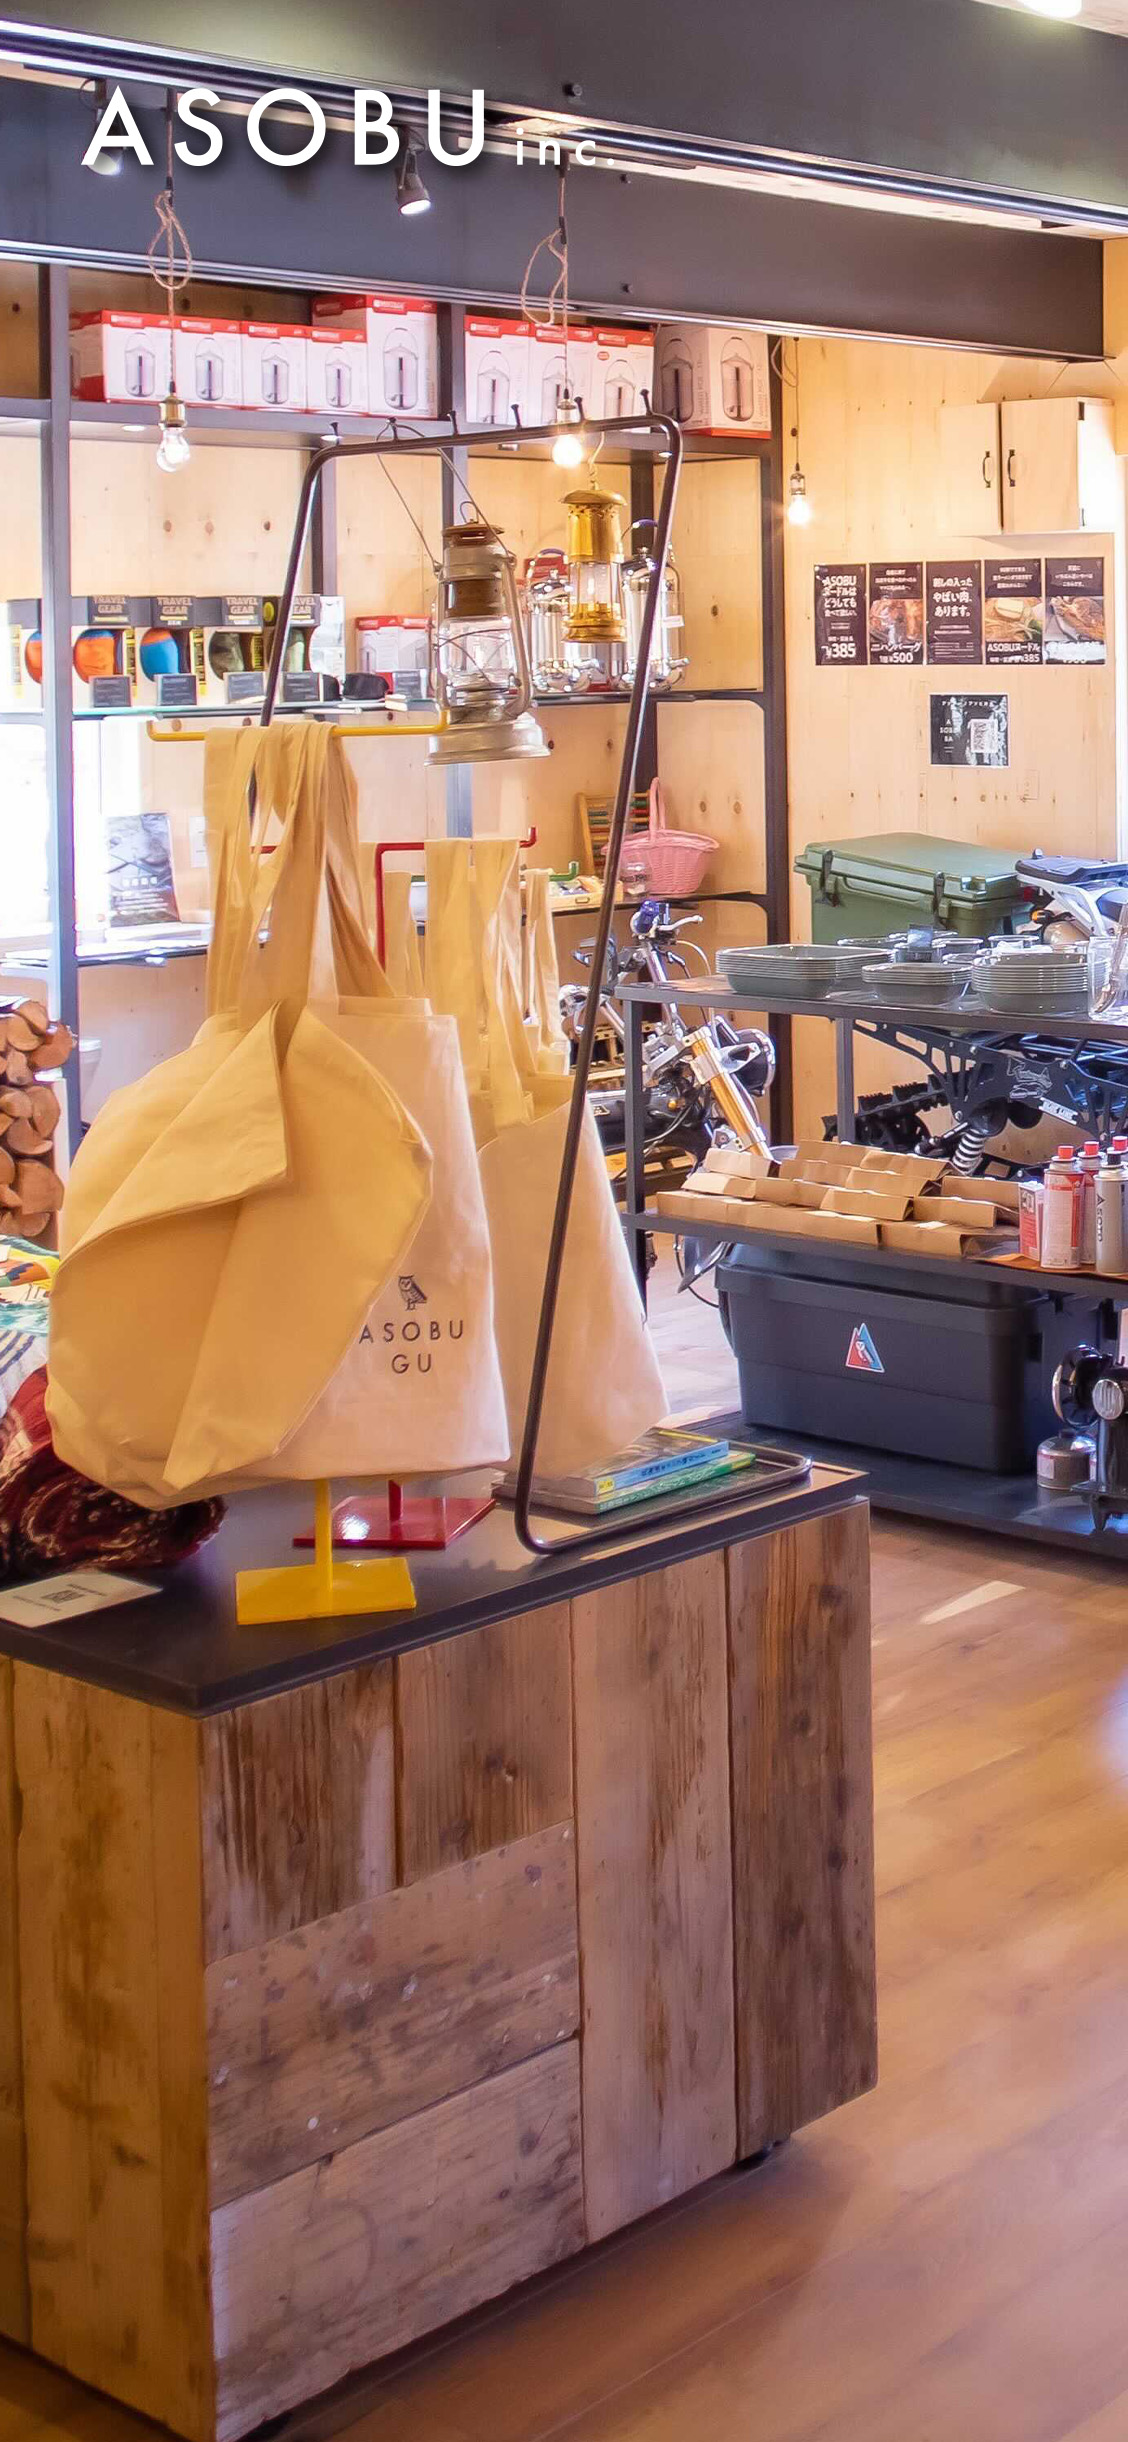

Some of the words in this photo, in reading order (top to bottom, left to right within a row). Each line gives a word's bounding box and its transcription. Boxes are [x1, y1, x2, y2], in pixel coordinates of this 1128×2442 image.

[822, 575, 857, 586] ASOBU
[157, 596, 192, 606] TRAVEL
[226, 596, 258, 606] TRAVEL
[824, 597, 857, 608] どうしても
[98, 604, 122, 614] GEAR
[162, 606, 188, 615] GEAR
[230, 605, 255, 614] GEAR
[934, 605, 971, 617] あります。
[358, 1320, 464, 1344] ASOBU
[391, 1353, 432, 1374] GU
